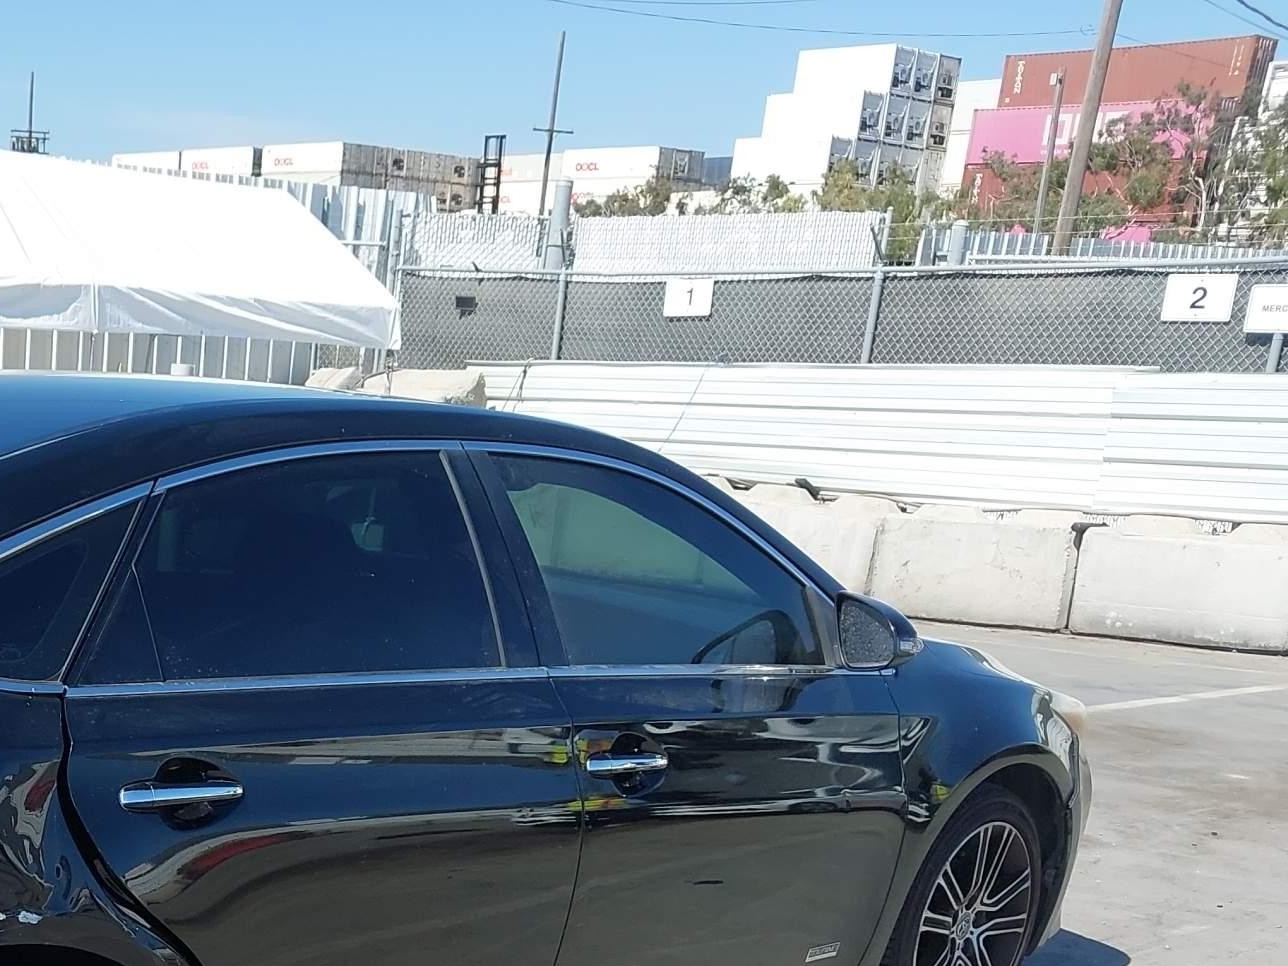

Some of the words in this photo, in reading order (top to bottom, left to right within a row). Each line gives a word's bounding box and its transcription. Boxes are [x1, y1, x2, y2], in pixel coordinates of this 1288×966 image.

[575, 162, 600, 172] OOCL
[687, 287, 694, 306] 1
[1189, 286, 1208, 309] 2
